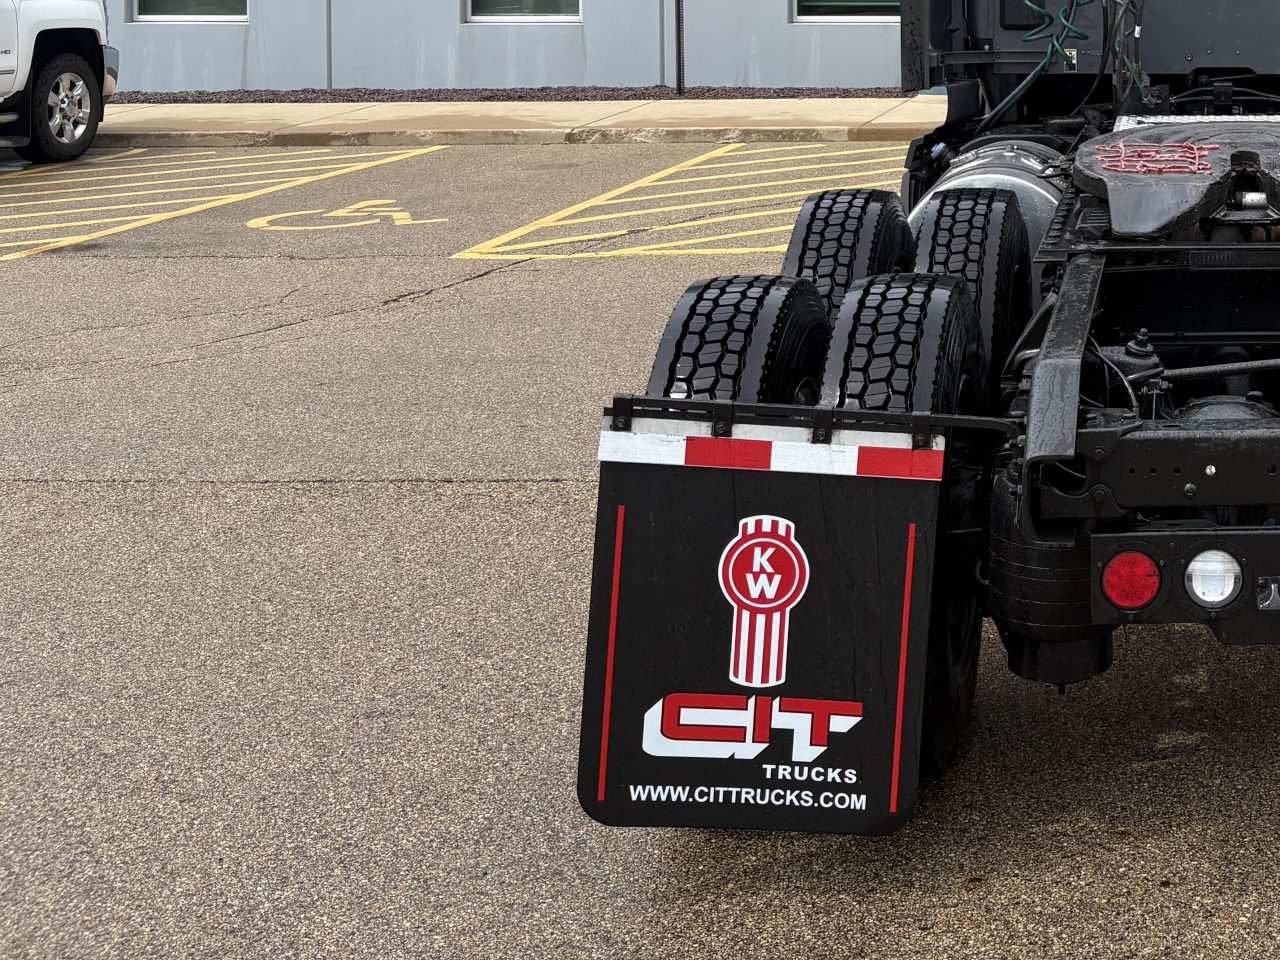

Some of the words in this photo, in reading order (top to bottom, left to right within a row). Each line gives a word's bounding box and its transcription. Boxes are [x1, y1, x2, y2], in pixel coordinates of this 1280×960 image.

[642, 692, 863, 763] CIT
[762, 764, 857, 784] TRUCKS
[629, 785, 867, 811] WWW.CITTRUCKS.COM
